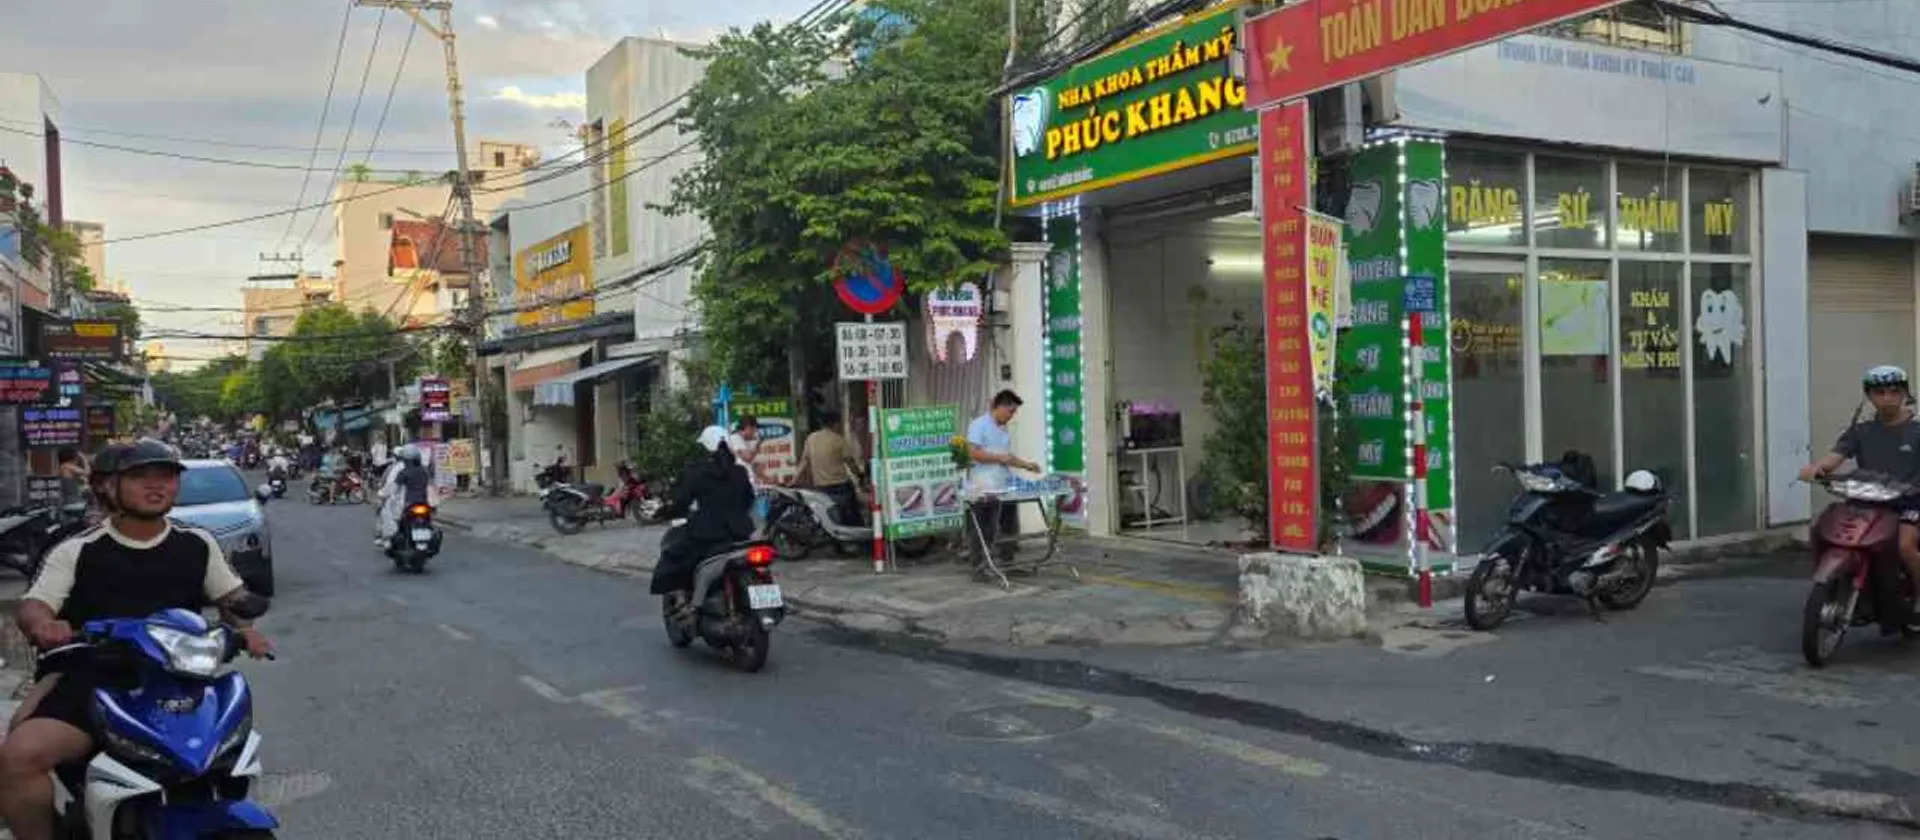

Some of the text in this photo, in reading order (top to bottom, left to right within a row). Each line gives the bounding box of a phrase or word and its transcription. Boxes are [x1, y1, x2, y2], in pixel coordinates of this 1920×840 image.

[1058, 26, 1235, 110] NHA KHOA THẨM MỸ
[1046, 75, 1246, 160] PHÚC KHANG
[1451, 179, 1734, 236] RĂNG SỨ THẨM MỸ
[1631, 288, 1669, 308] KHÁM
